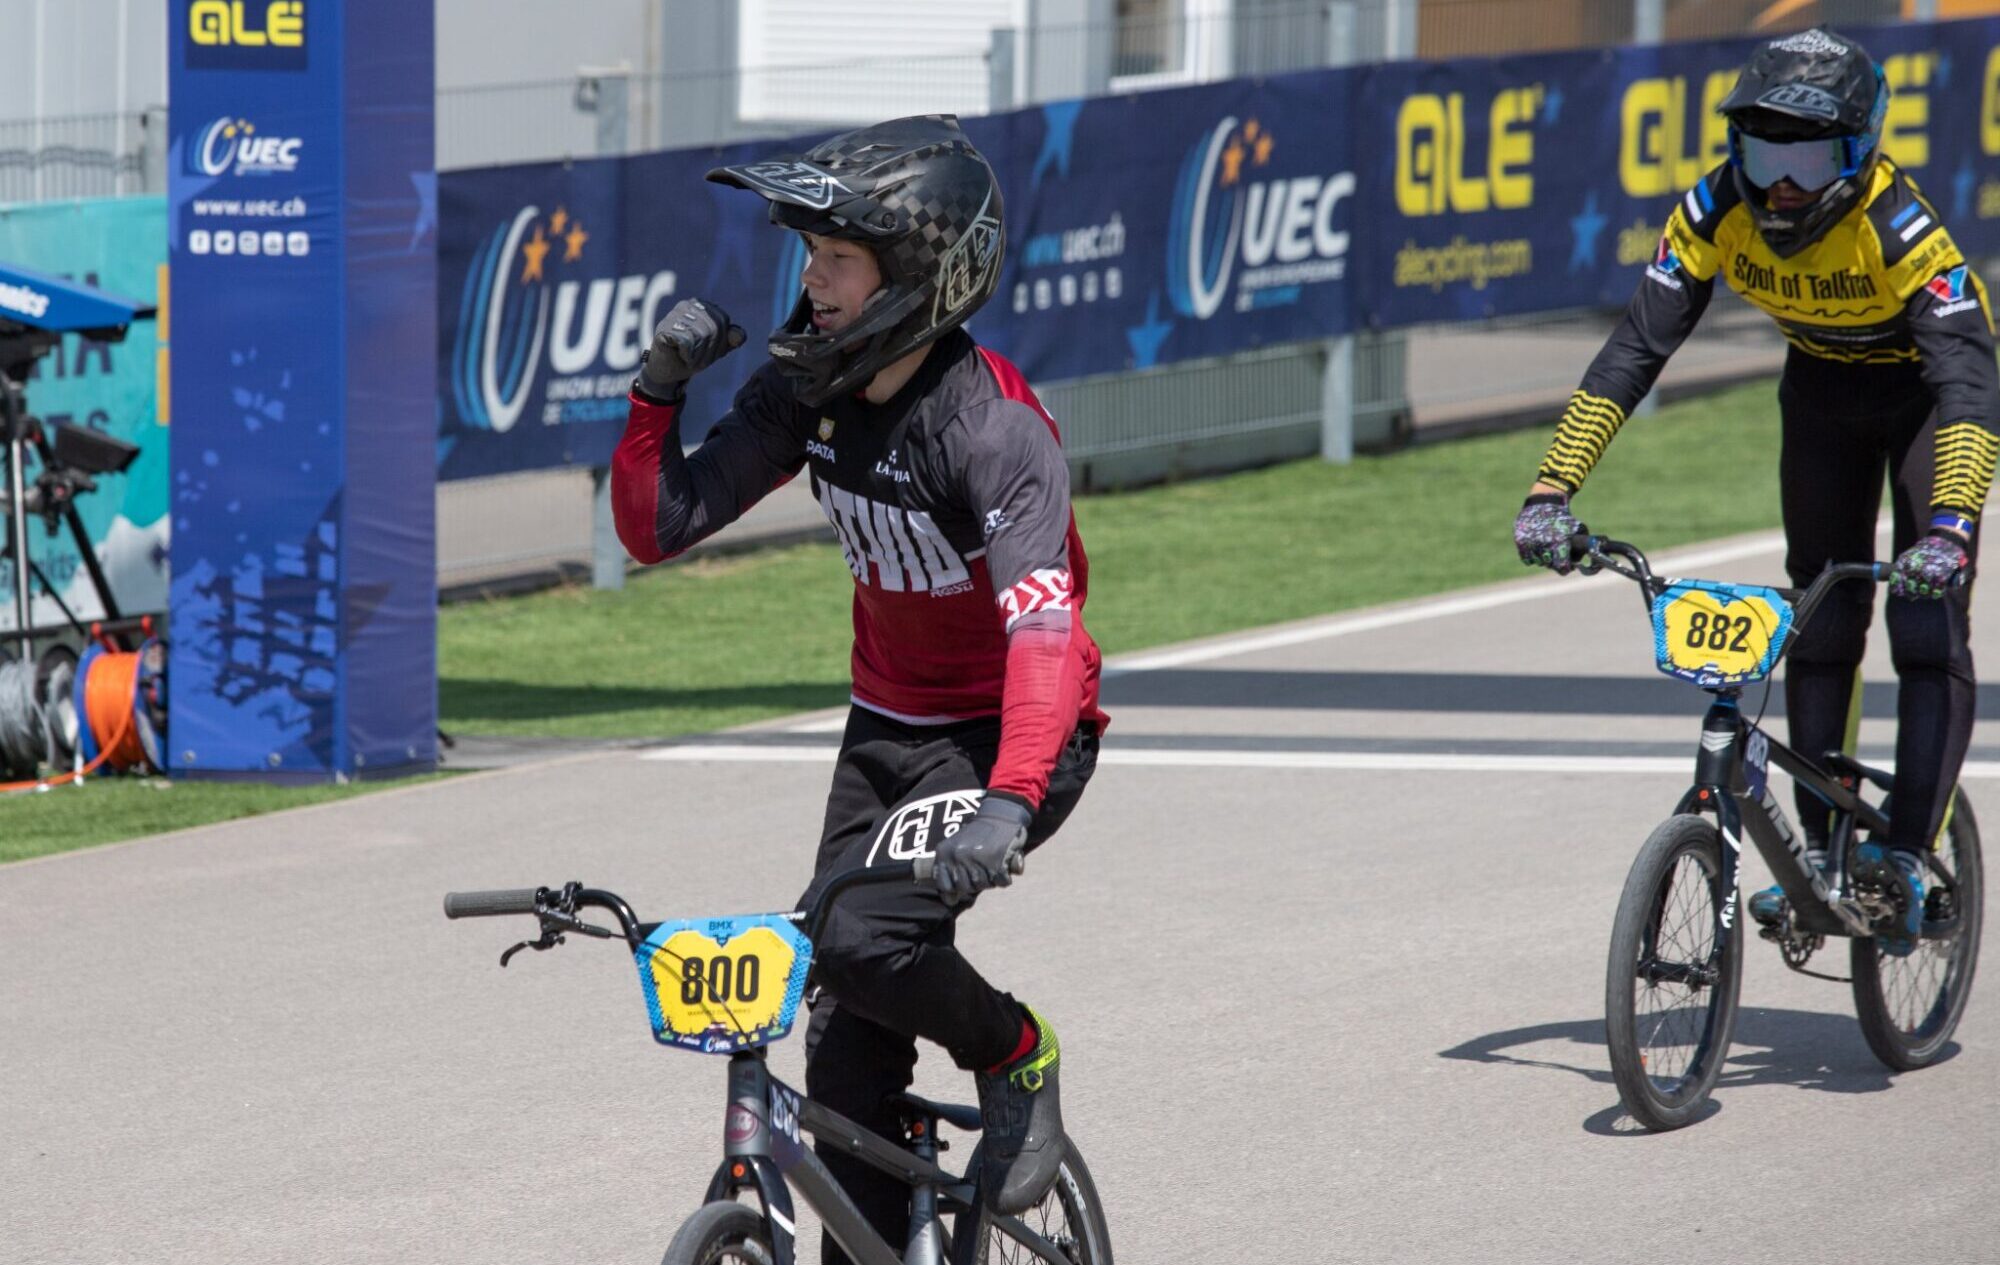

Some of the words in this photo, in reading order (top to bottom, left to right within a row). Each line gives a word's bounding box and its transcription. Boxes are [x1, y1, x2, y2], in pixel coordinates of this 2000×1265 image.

[237, 136, 303, 166] UEC
[193, 196, 306, 217] www.uec.ch
[1242, 171, 1357, 267] UEC
[1734, 252, 1777, 294] Spot
[1781, 273, 1801, 299] of
[550, 270, 677, 374] UEC
[806, 439, 836, 463] PATA
[1686, 611, 1752, 653] 882
[709, 920, 734, 931] BMX
[681, 953, 760, 1005] 800
